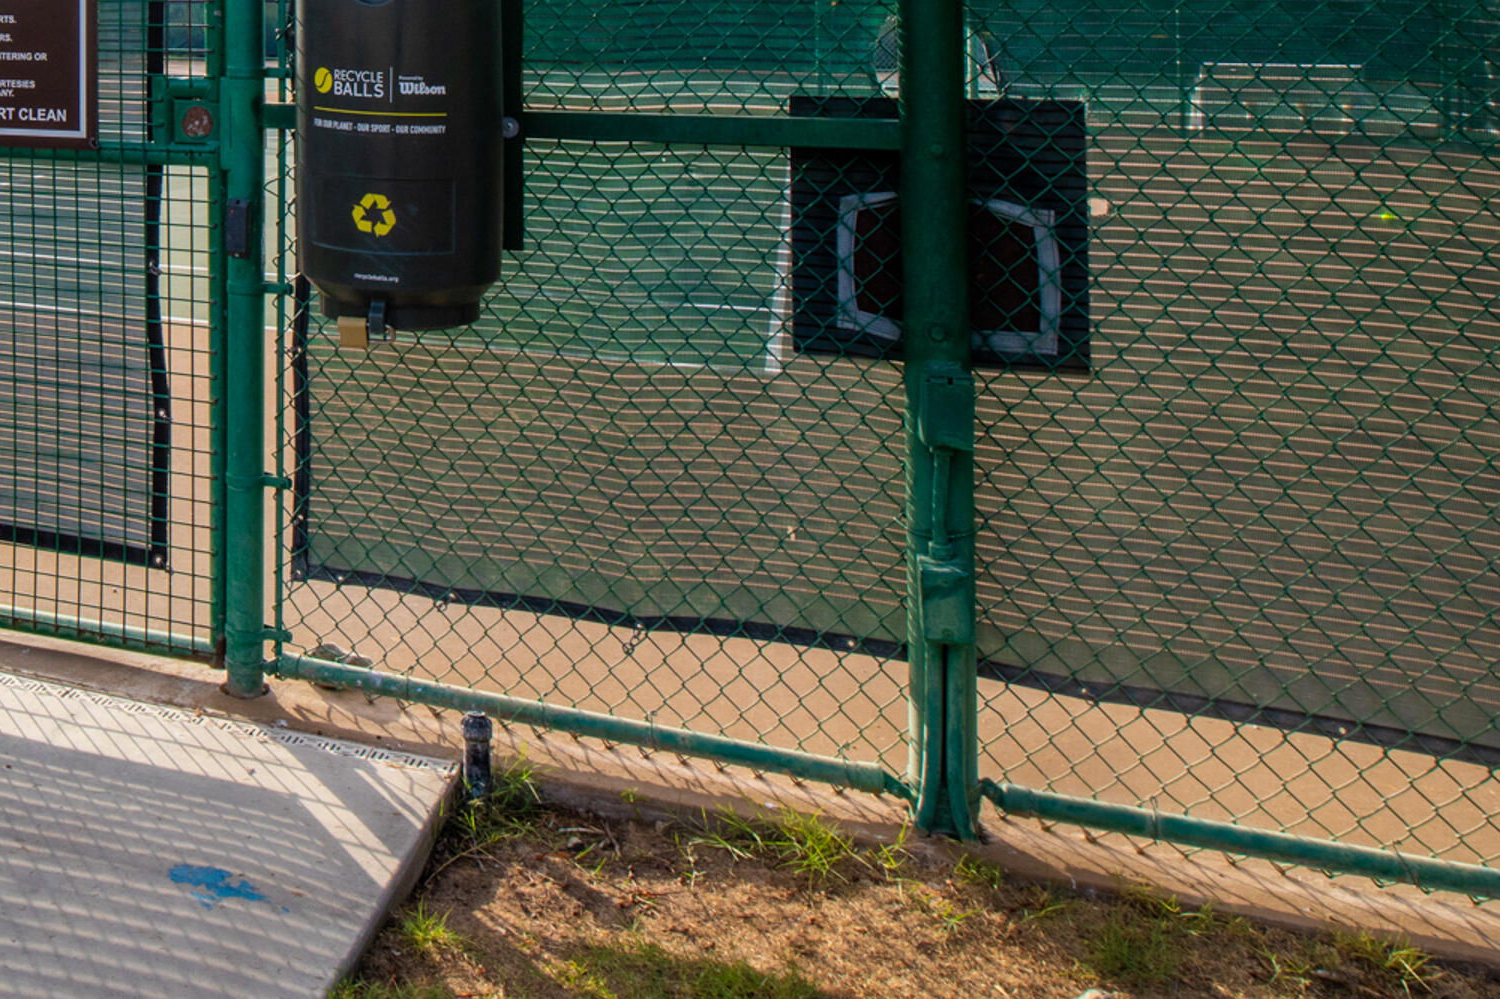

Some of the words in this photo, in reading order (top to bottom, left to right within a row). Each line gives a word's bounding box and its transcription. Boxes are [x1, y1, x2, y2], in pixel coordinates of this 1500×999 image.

[334, 69, 383, 84] RECYCLE
[334, 81, 384, 98] BALLS
[399, 82, 446, 94] Wilson
[19, 108, 67, 122] CLEAN
[324, 119, 332, 128] OUR
[333, 120, 352, 130] PLANET
[357, 123, 369, 132] OUR
[371, 124, 390, 133] SPORT
[396, 125, 408, 133] OUR
[410, 125, 446, 134] COMMUNITY
